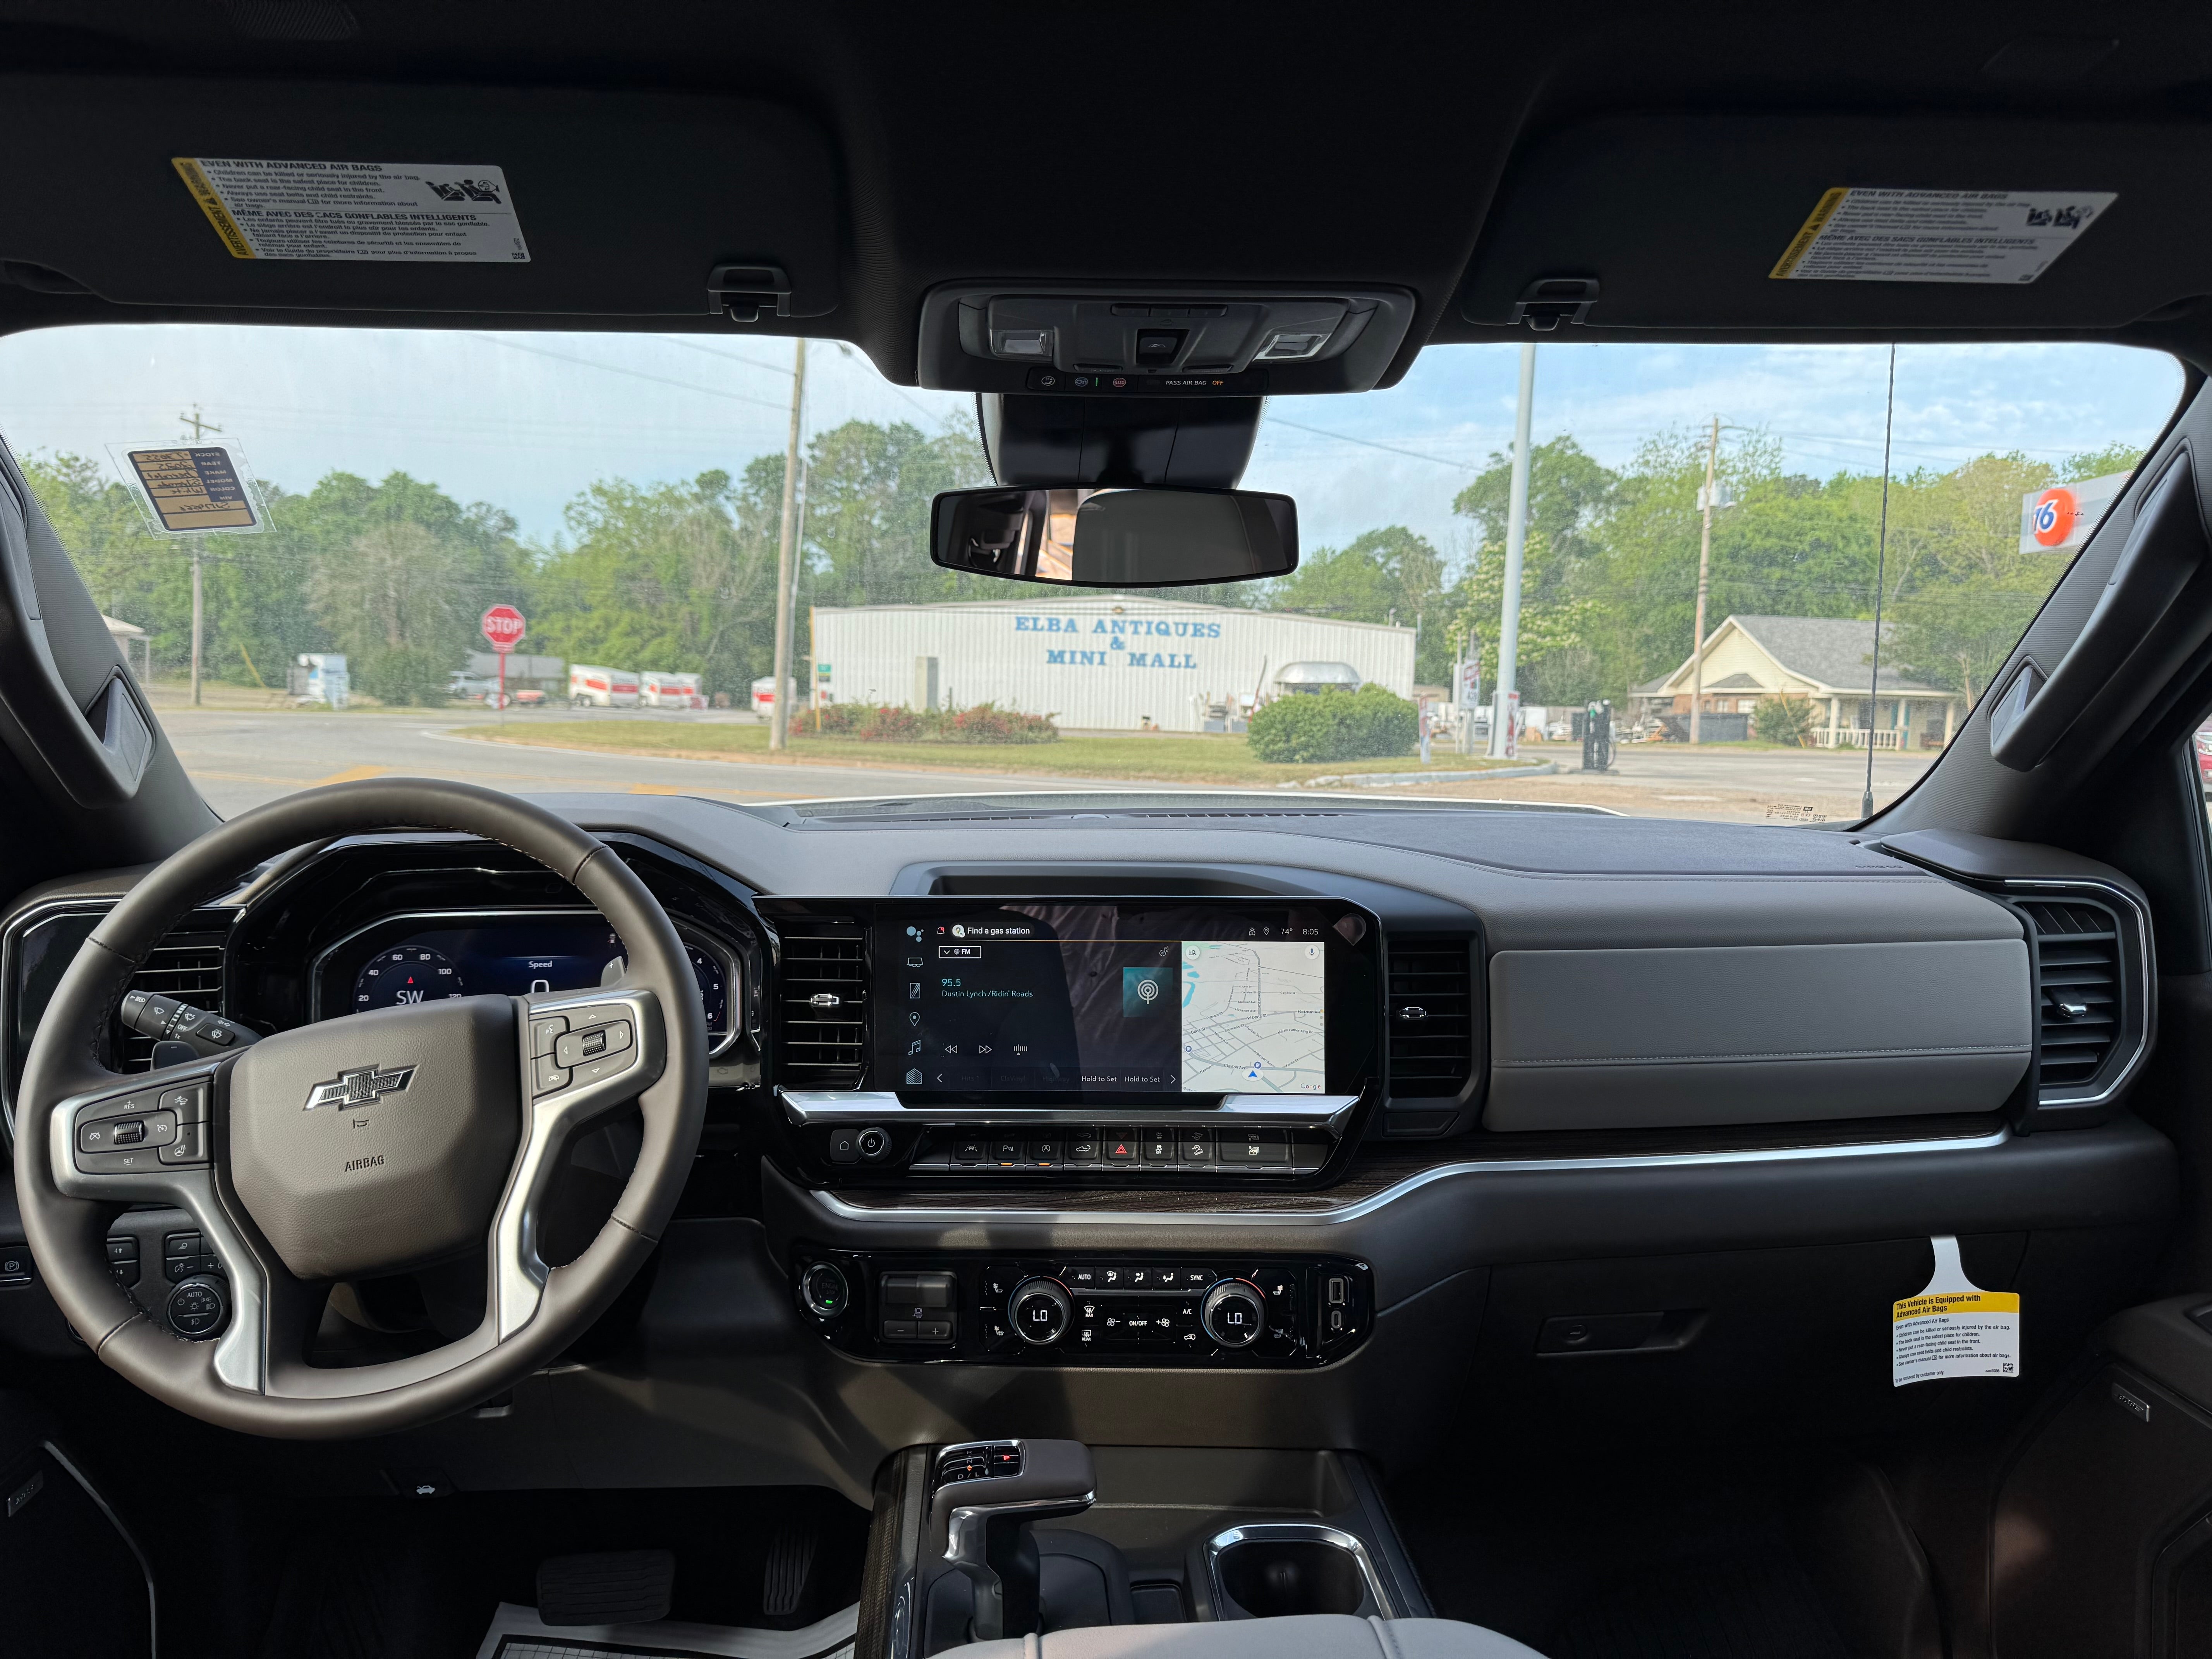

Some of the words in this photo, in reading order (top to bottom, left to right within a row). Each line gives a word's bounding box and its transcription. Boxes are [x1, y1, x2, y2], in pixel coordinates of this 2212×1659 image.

[2033, 499, 2059, 535] 76
[486, 617, 523, 635] STOP
[1015, 616, 1078, 633] ELBA
[1092, 618, 1221, 638] ANTIQUES
[1110, 636, 1125, 651] &
[1046, 649, 1107, 666] MINI
[1128, 652, 1197, 669] MALL
[942, 979, 961, 987] 95.5
[396, 990, 424, 1005] SW
[967, 991, 986, 999] Lynch
[345, 1155, 384, 1172] AIRBAG
[1908, 1298, 1927, 1307] Vehicle
[1935, 1295, 1964, 1304] Equipped
[1896, 1307, 1921, 1319] Advanced
